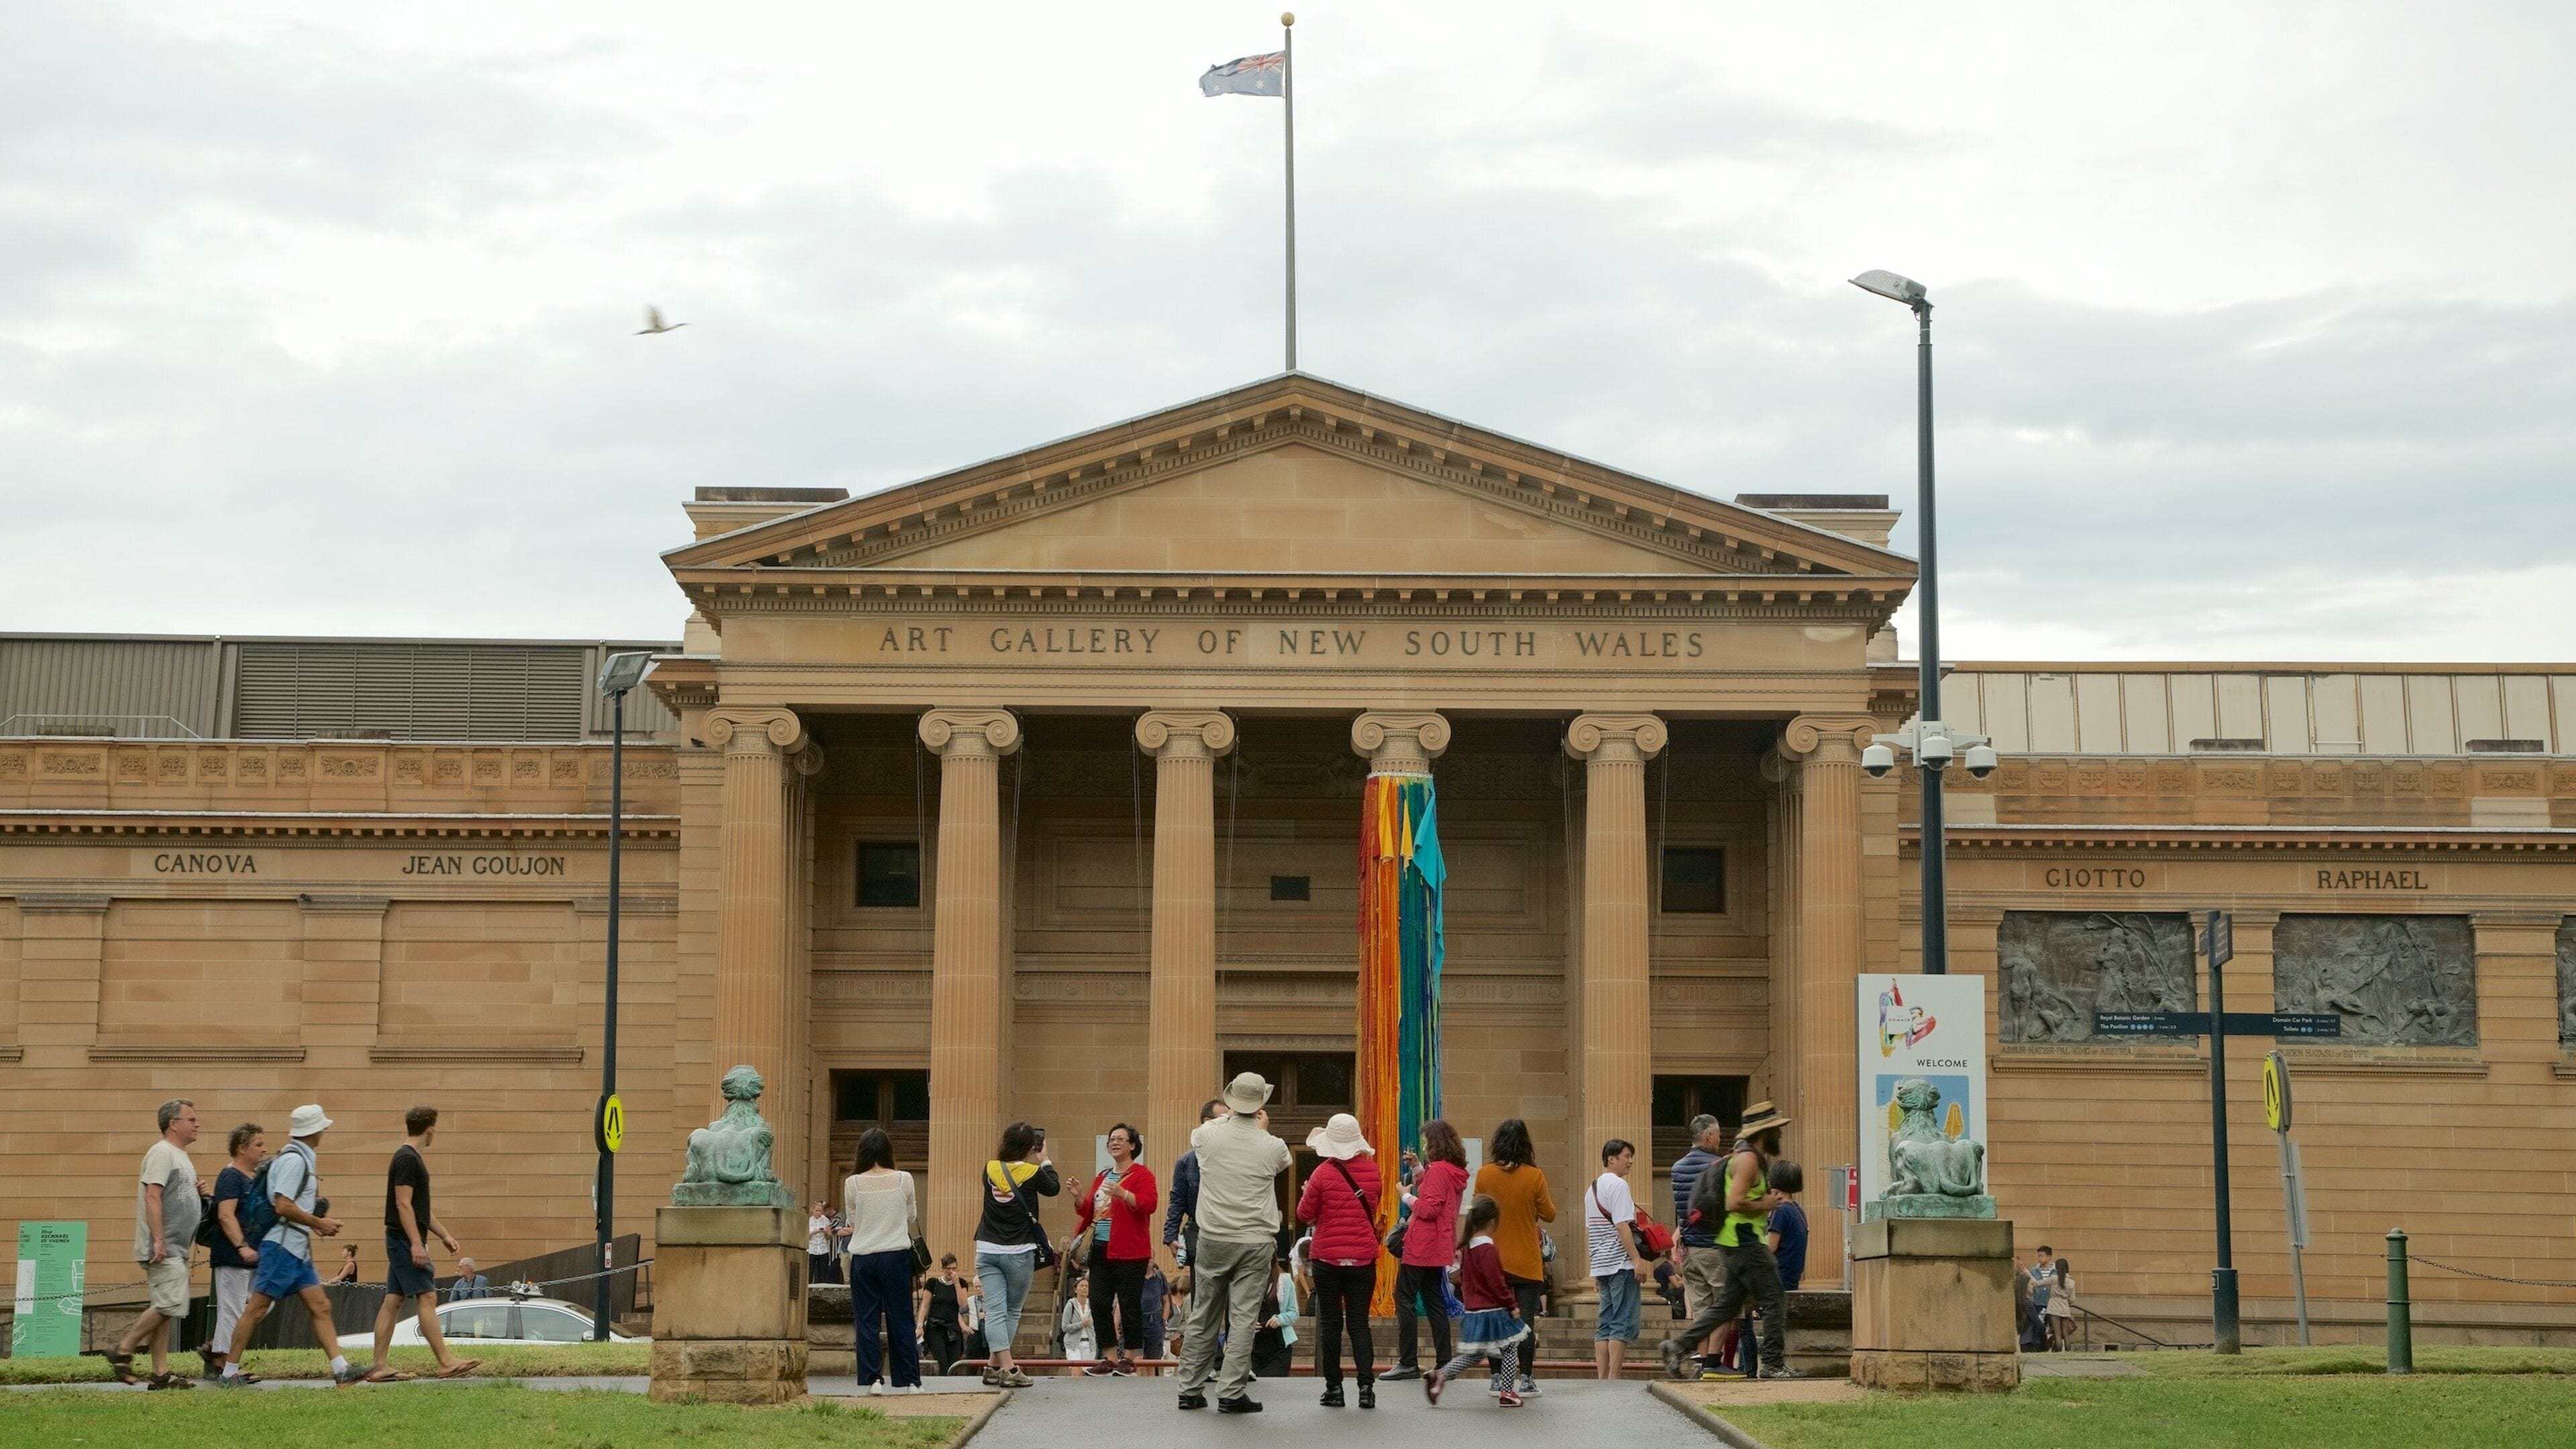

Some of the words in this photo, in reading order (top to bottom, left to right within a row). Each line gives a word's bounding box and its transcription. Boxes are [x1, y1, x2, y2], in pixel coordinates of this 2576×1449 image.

[879, 627, 953, 652] ART
[990, 627, 1161, 653] GALLERY
[1197, 629, 1242, 654] OF
[1279, 630, 1366, 655] NEW
[1404, 631, 1536, 657] SOUTH
[1575, 632, 1704, 658] WALES
[154, 854, 258, 873] CANOVA
[402, 855, 463, 875] JEAN
[472, 856, 566, 875] GOUJON
[2045, 869, 2145, 888] GIOTTO
[2317, 870, 2428, 890] RAPHAEL
[1917, 1059, 1968, 1067] WELCOME
[606, 1258, 610, 1267] R
